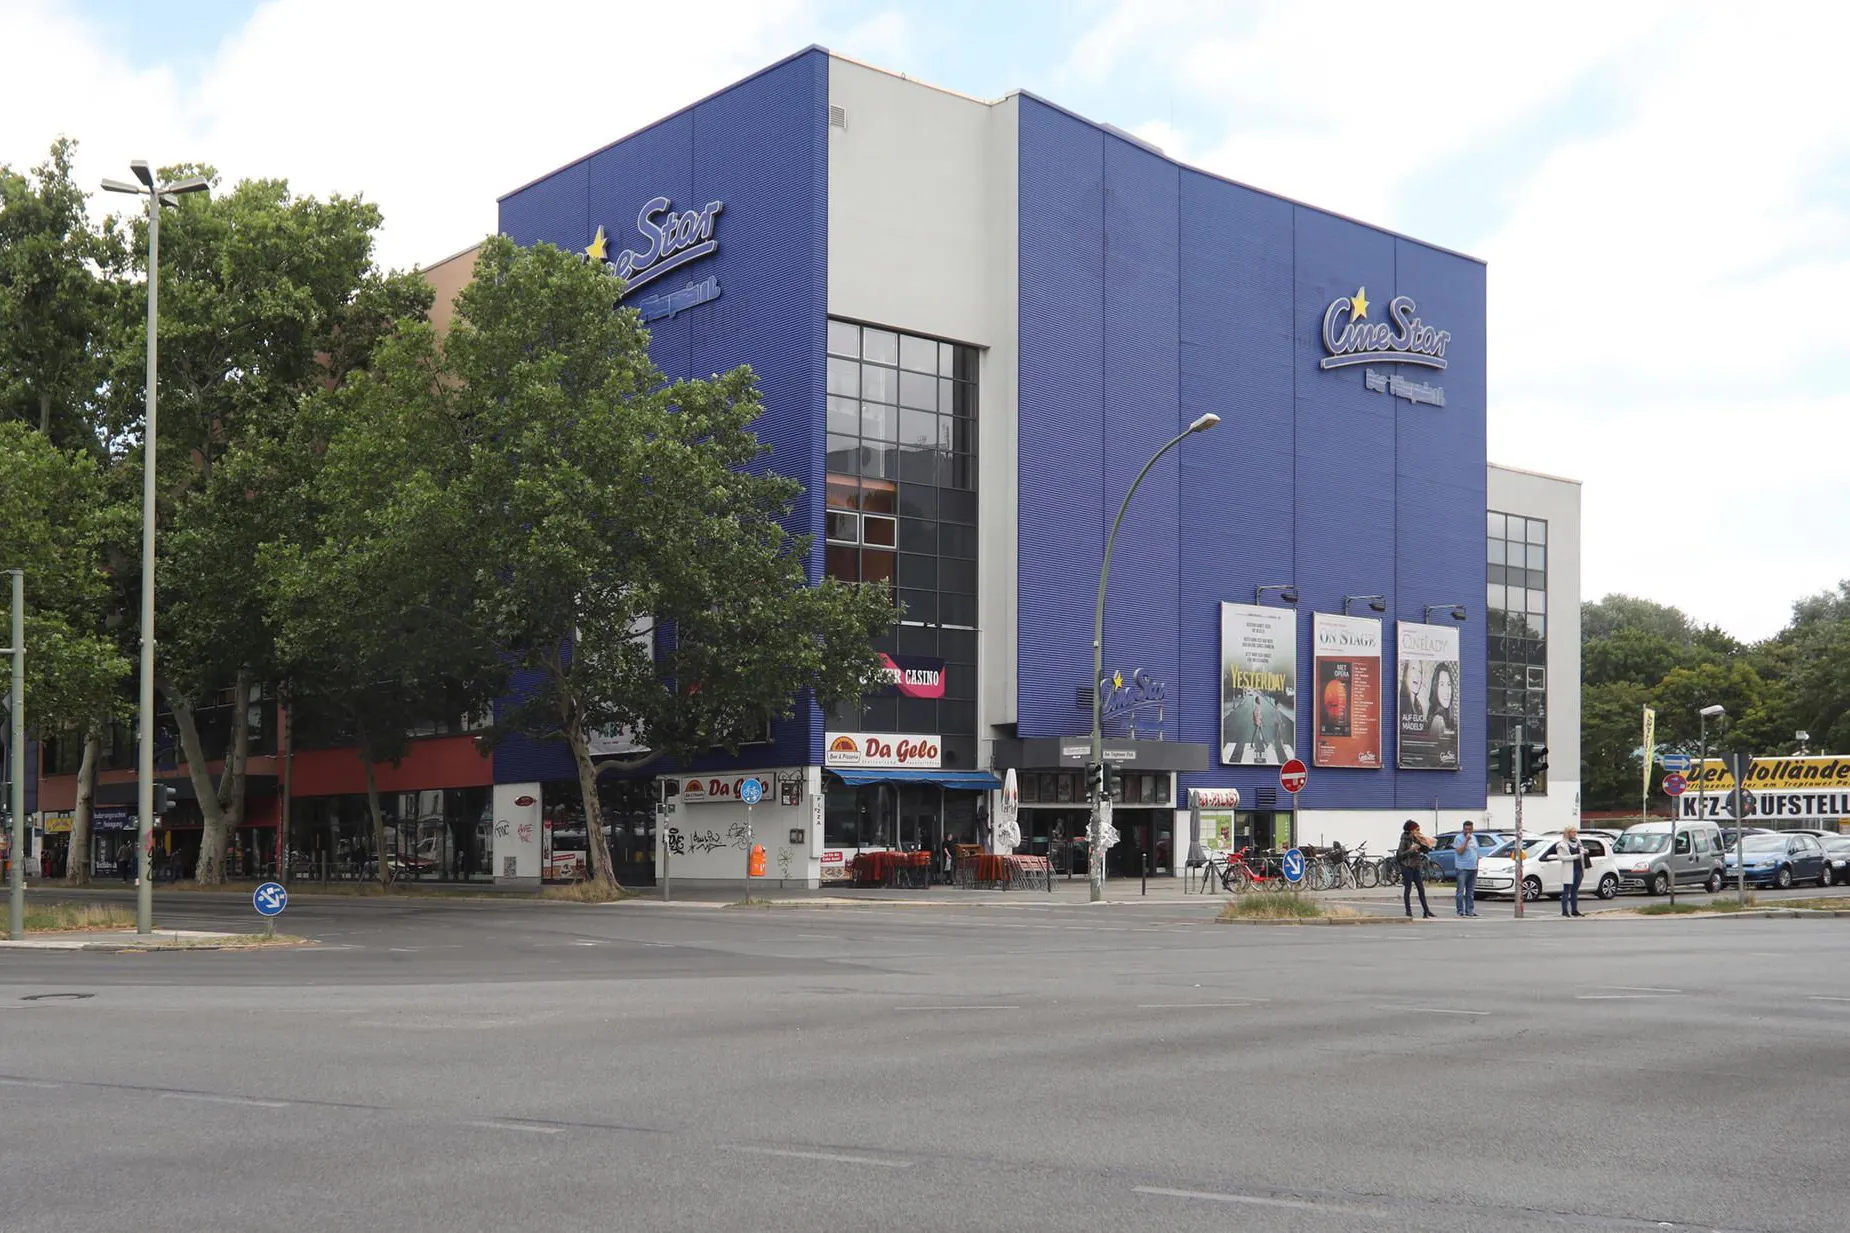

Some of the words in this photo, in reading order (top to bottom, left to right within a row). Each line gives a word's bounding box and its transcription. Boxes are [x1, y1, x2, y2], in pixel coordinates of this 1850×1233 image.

[1323, 287, 1451, 357] CineStar
[1319, 630, 1337, 644] ON
[905, 669, 939, 686] CASINO
[1230, 663, 1286, 692] YESTERDAY
[865, 737, 892, 758] Da
[896, 739, 938, 763] Gelo
[1686, 764, 1727, 781] Der
[708, 778, 730, 796] Da
[733, 777, 769, 799] Go
[1683, 792, 1850, 817] KZ-ÜFSTELL
